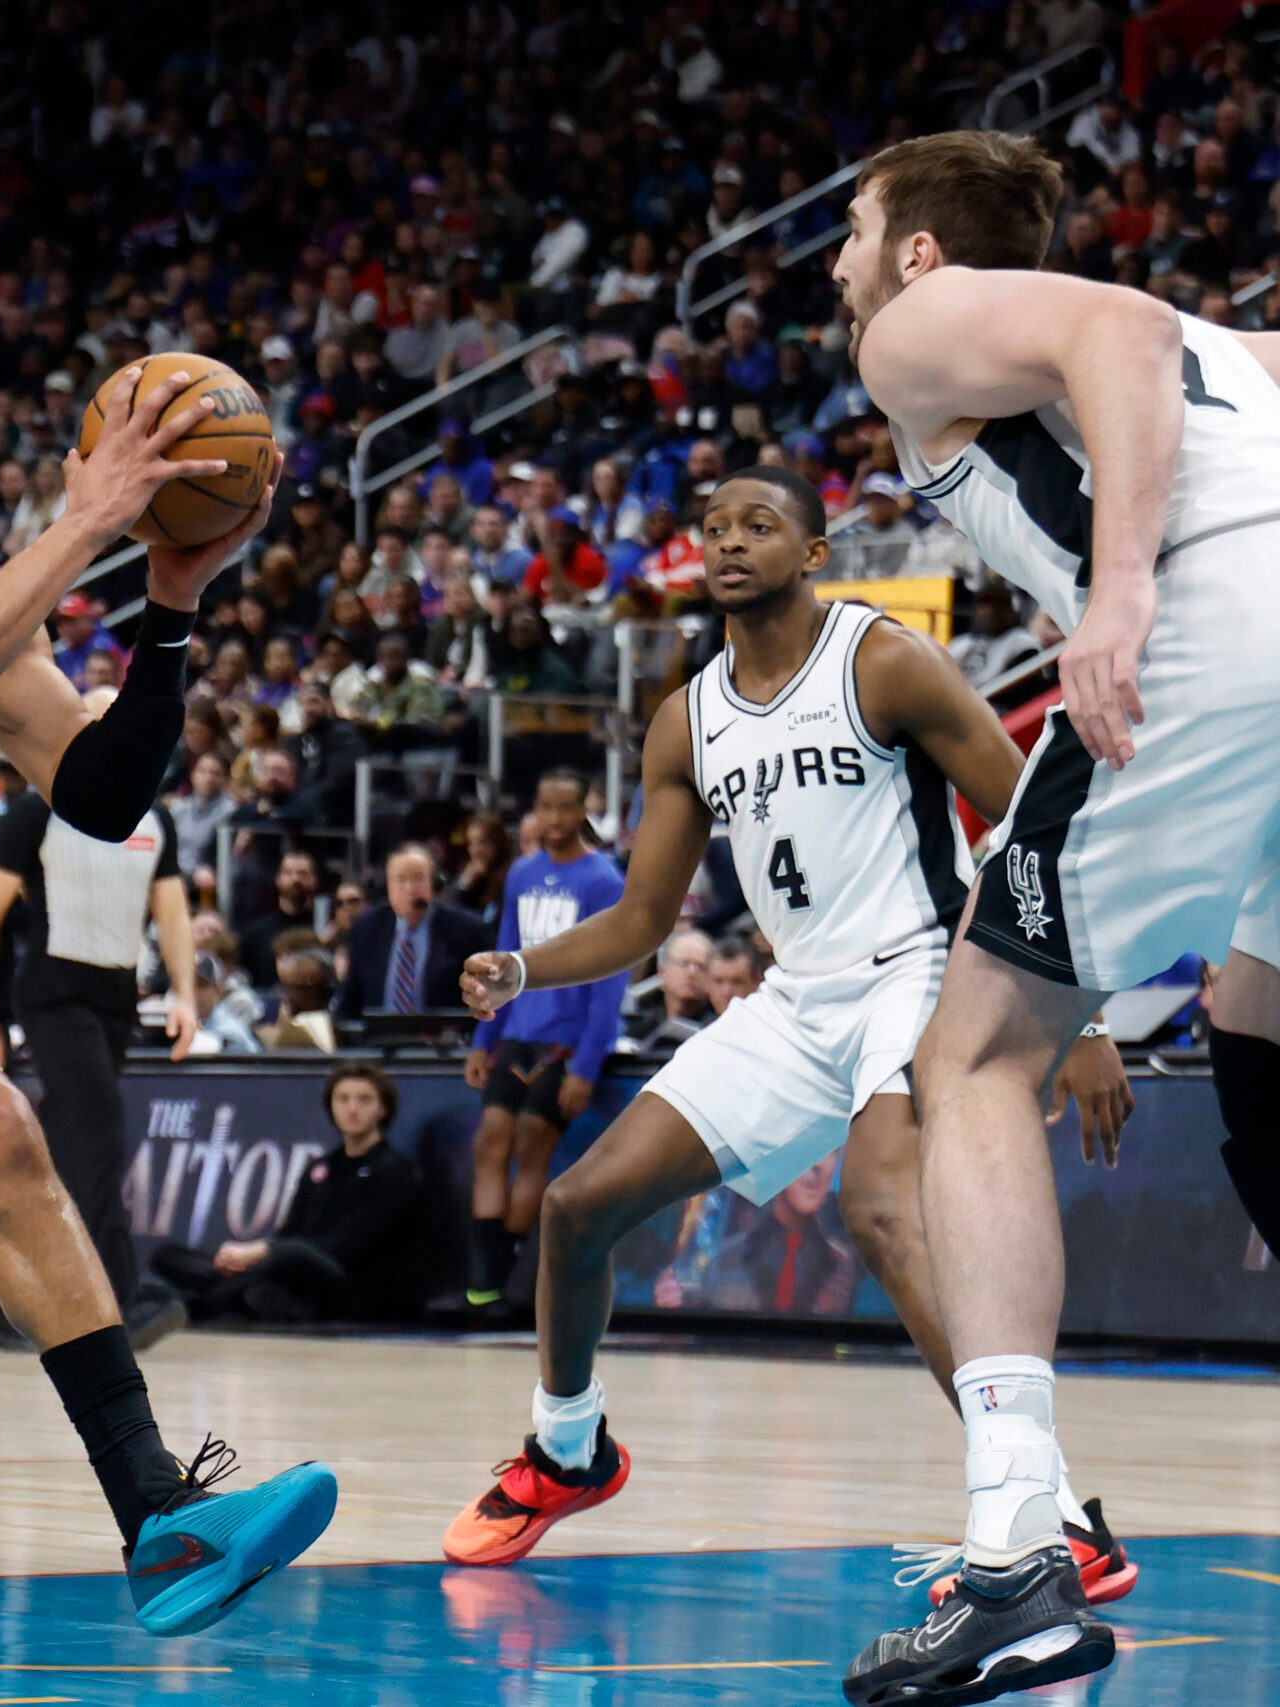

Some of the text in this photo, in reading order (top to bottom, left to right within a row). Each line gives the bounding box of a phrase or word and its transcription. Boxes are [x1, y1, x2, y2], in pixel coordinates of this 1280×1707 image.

[794, 709, 830, 725] LEDGER
[707, 746, 866, 827] SPURS
[768, 836, 814, 912] 4
[147, 1098, 196, 1138] THE
